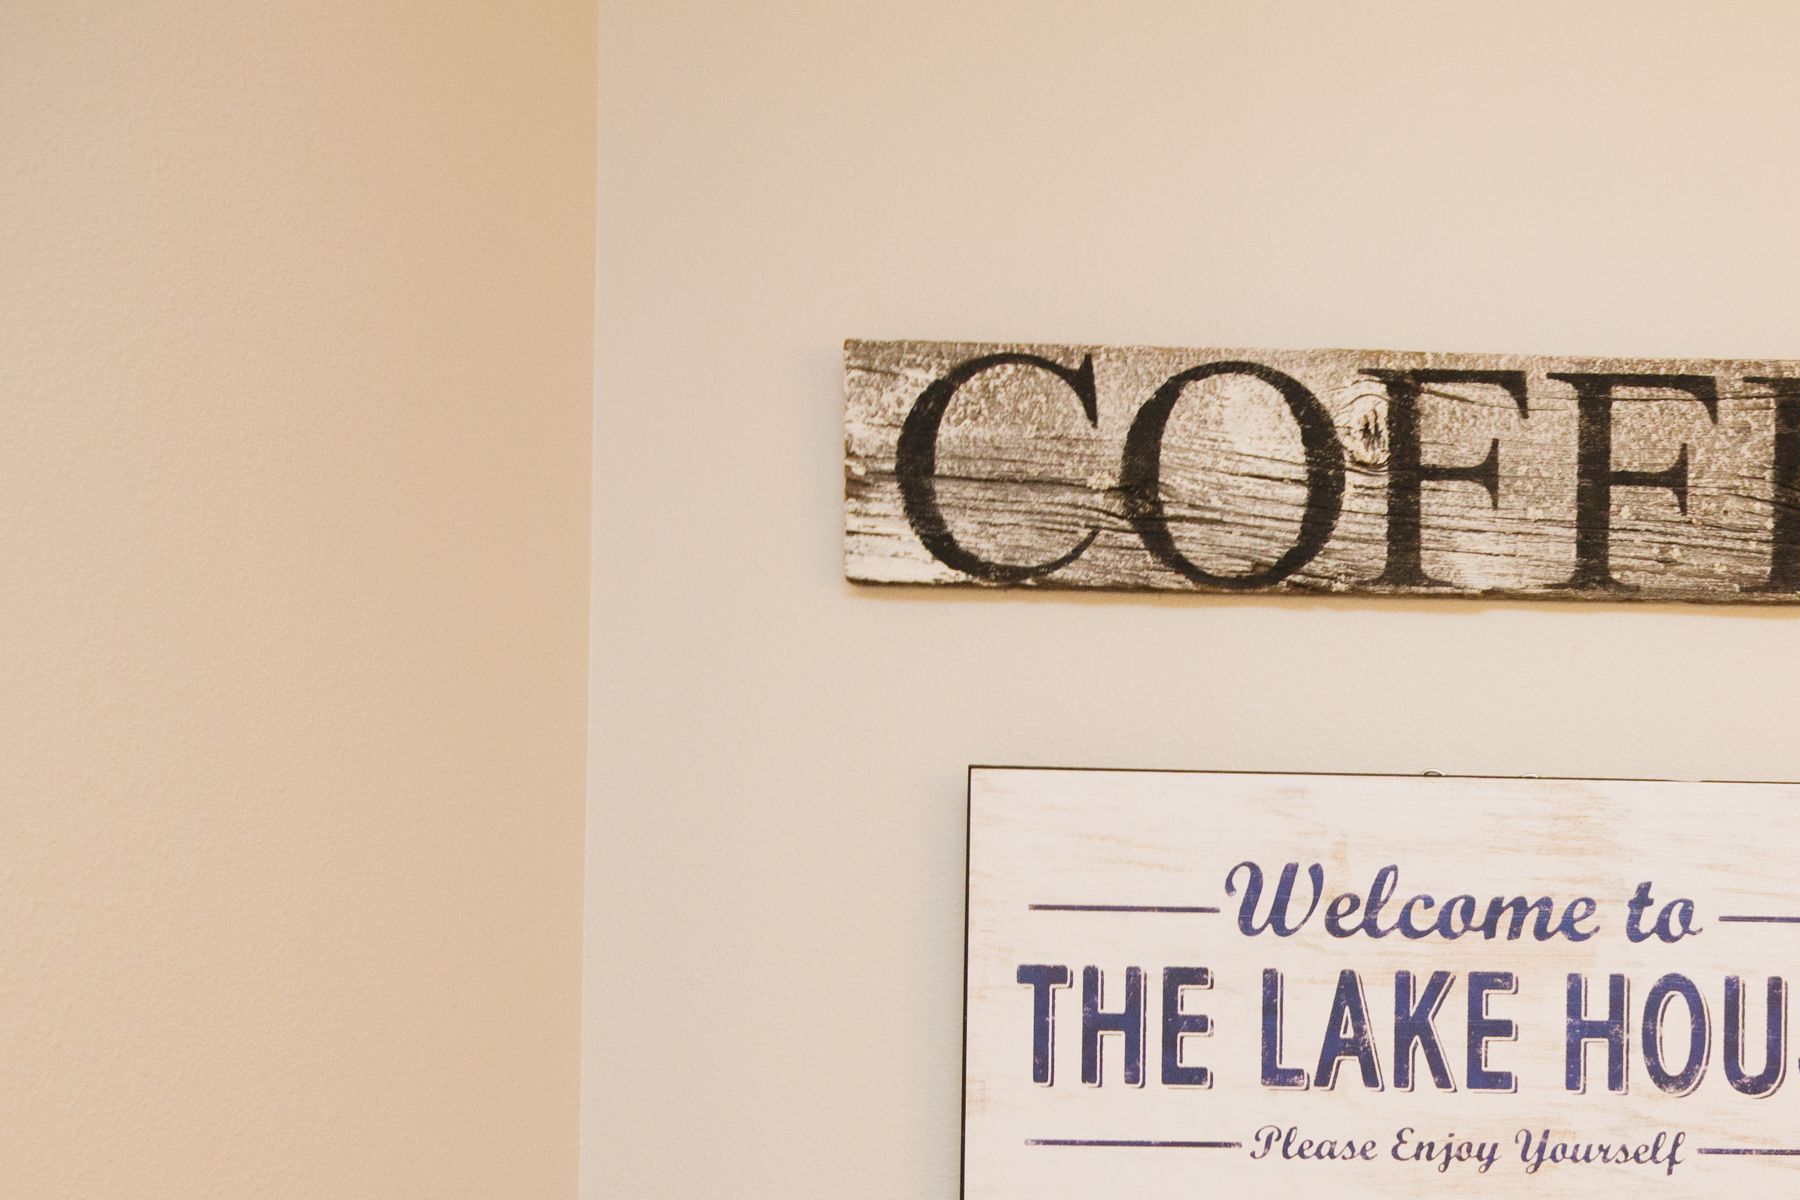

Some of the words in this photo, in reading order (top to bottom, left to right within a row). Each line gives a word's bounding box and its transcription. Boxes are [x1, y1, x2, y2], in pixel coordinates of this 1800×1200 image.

[1225, 861, 1601, 943] Welcome
[1627, 881, 1703, 945] to
[1016, 963, 1214, 1089] THE
[1260, 967, 1518, 1094] LAKE
[1249, 1125, 1377, 1162] Please
[1391, 1126, 1500, 1174] Enjoy
[1514, 1128, 1688, 1176] Yourself
